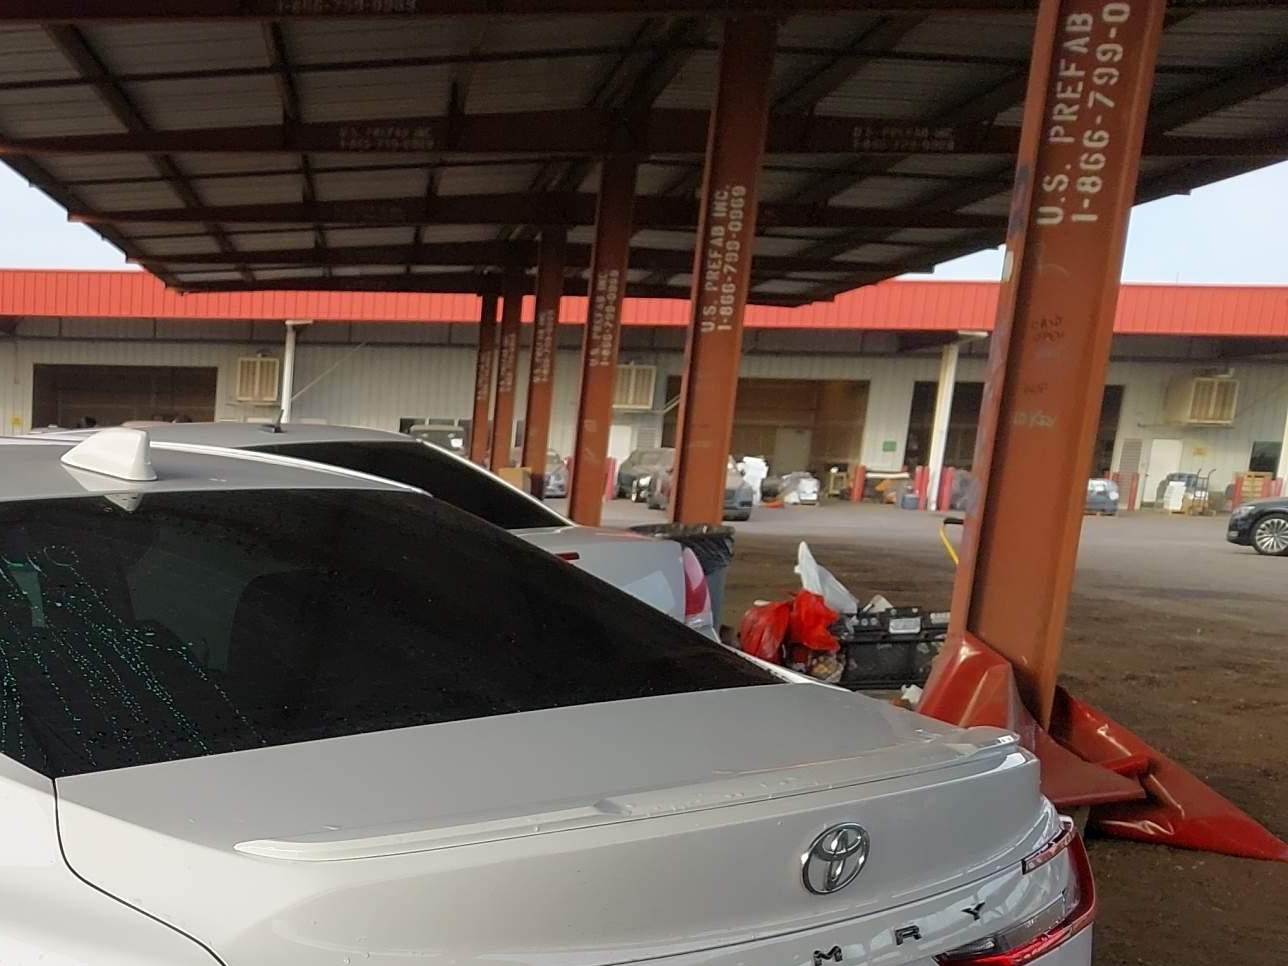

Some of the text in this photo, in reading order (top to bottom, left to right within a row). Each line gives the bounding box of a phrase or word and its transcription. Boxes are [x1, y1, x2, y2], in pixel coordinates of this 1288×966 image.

[1036, 12, 1094, 226] U.S. PREFAB
[1071, 1, 1131, 223] 1-866-799-0
[704, 225, 726, 292] PREFAB
